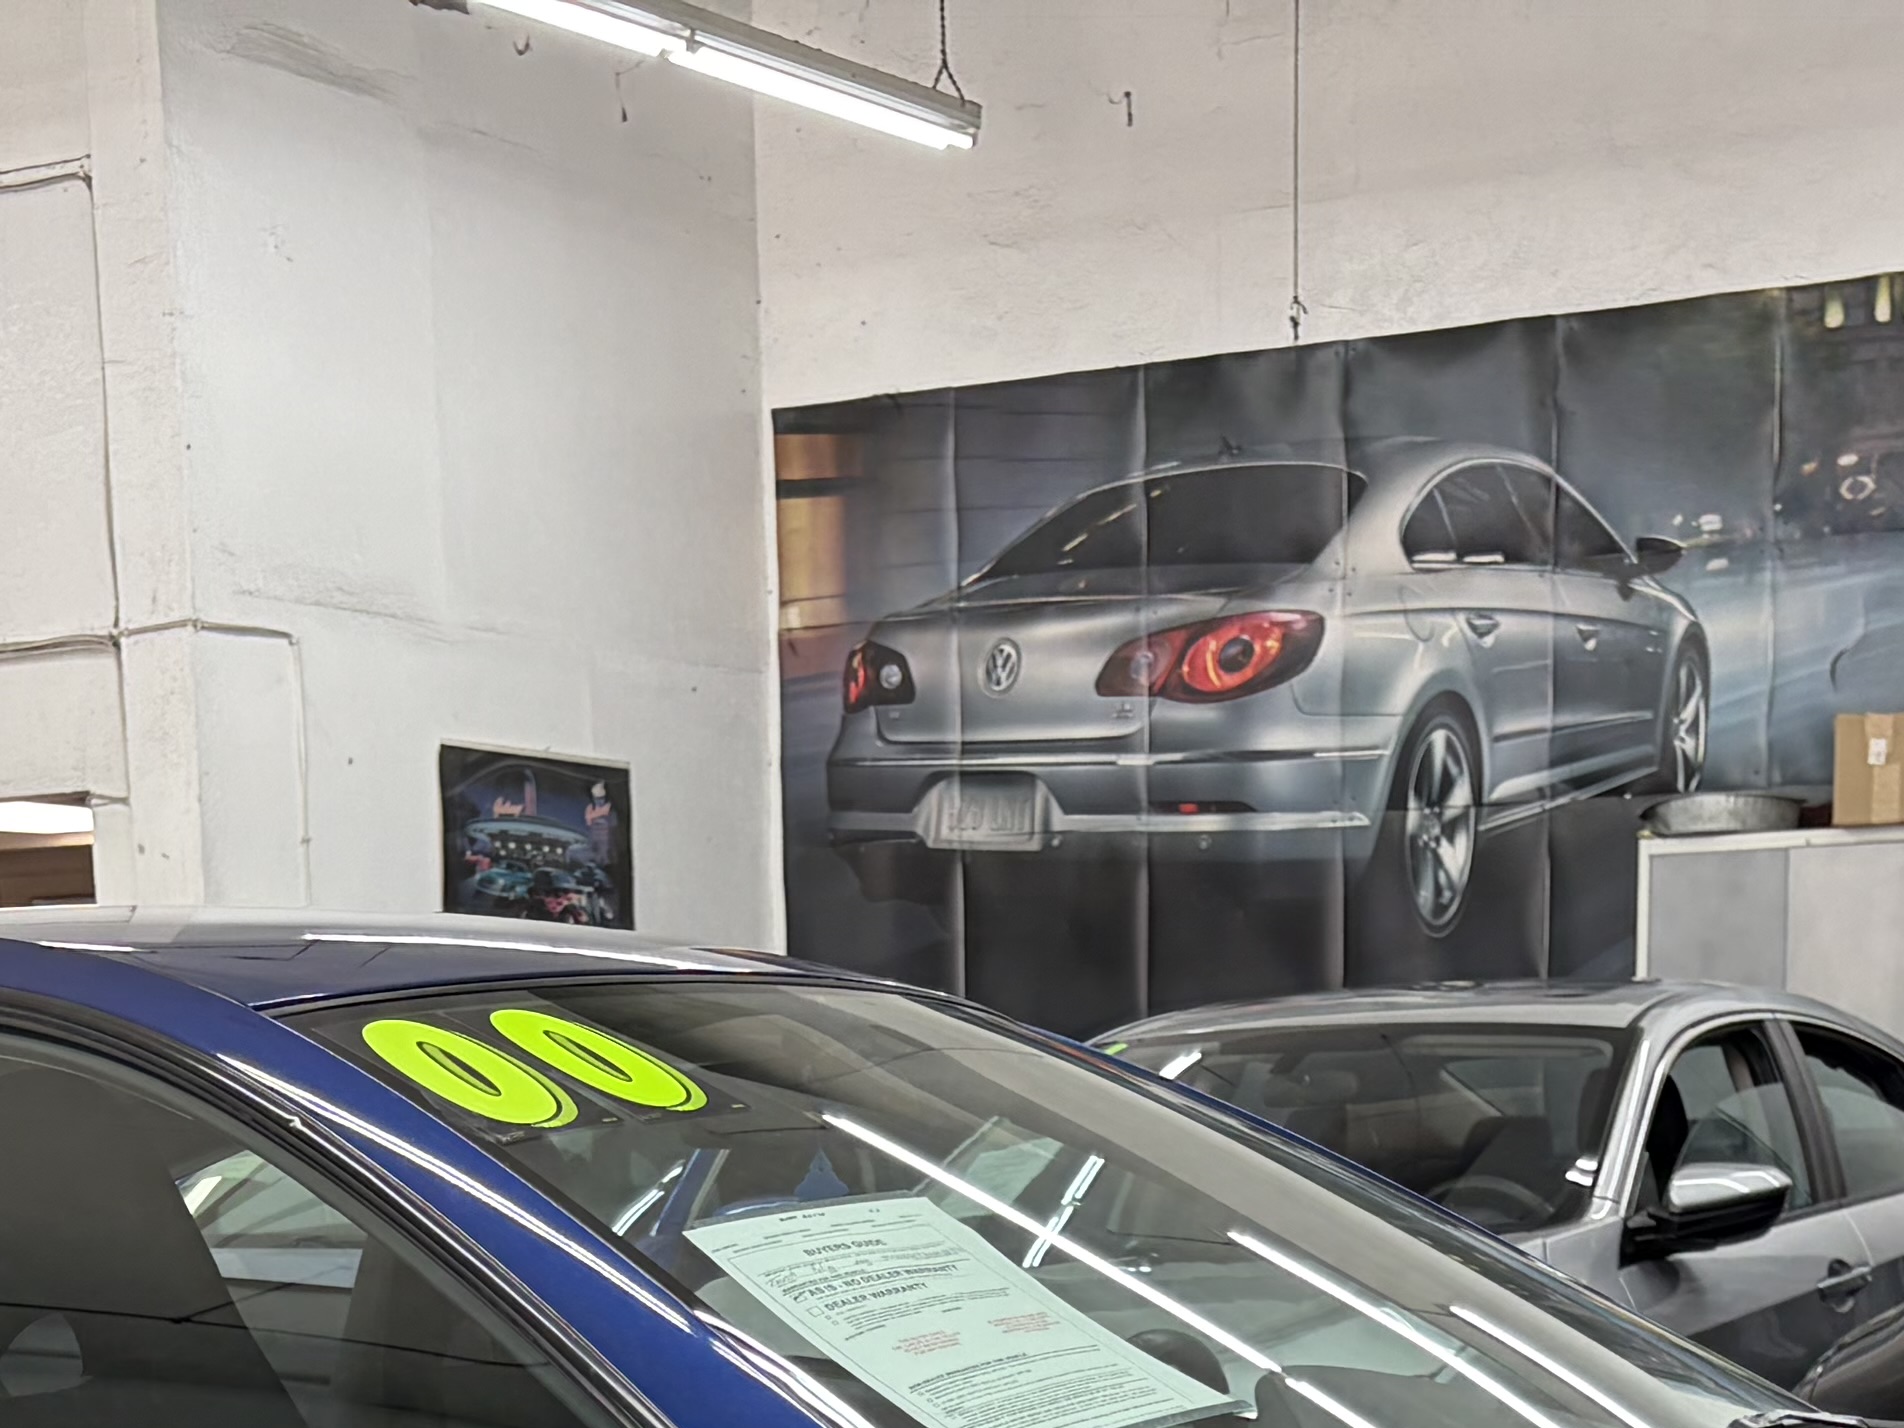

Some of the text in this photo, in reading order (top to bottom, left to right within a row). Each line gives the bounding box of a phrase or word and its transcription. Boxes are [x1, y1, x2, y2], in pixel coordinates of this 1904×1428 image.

[361, 1008, 708, 1128] 00
[824, 1294, 870, 1312] DEALER
[869, 1282, 928, 1300] WARRANTY
